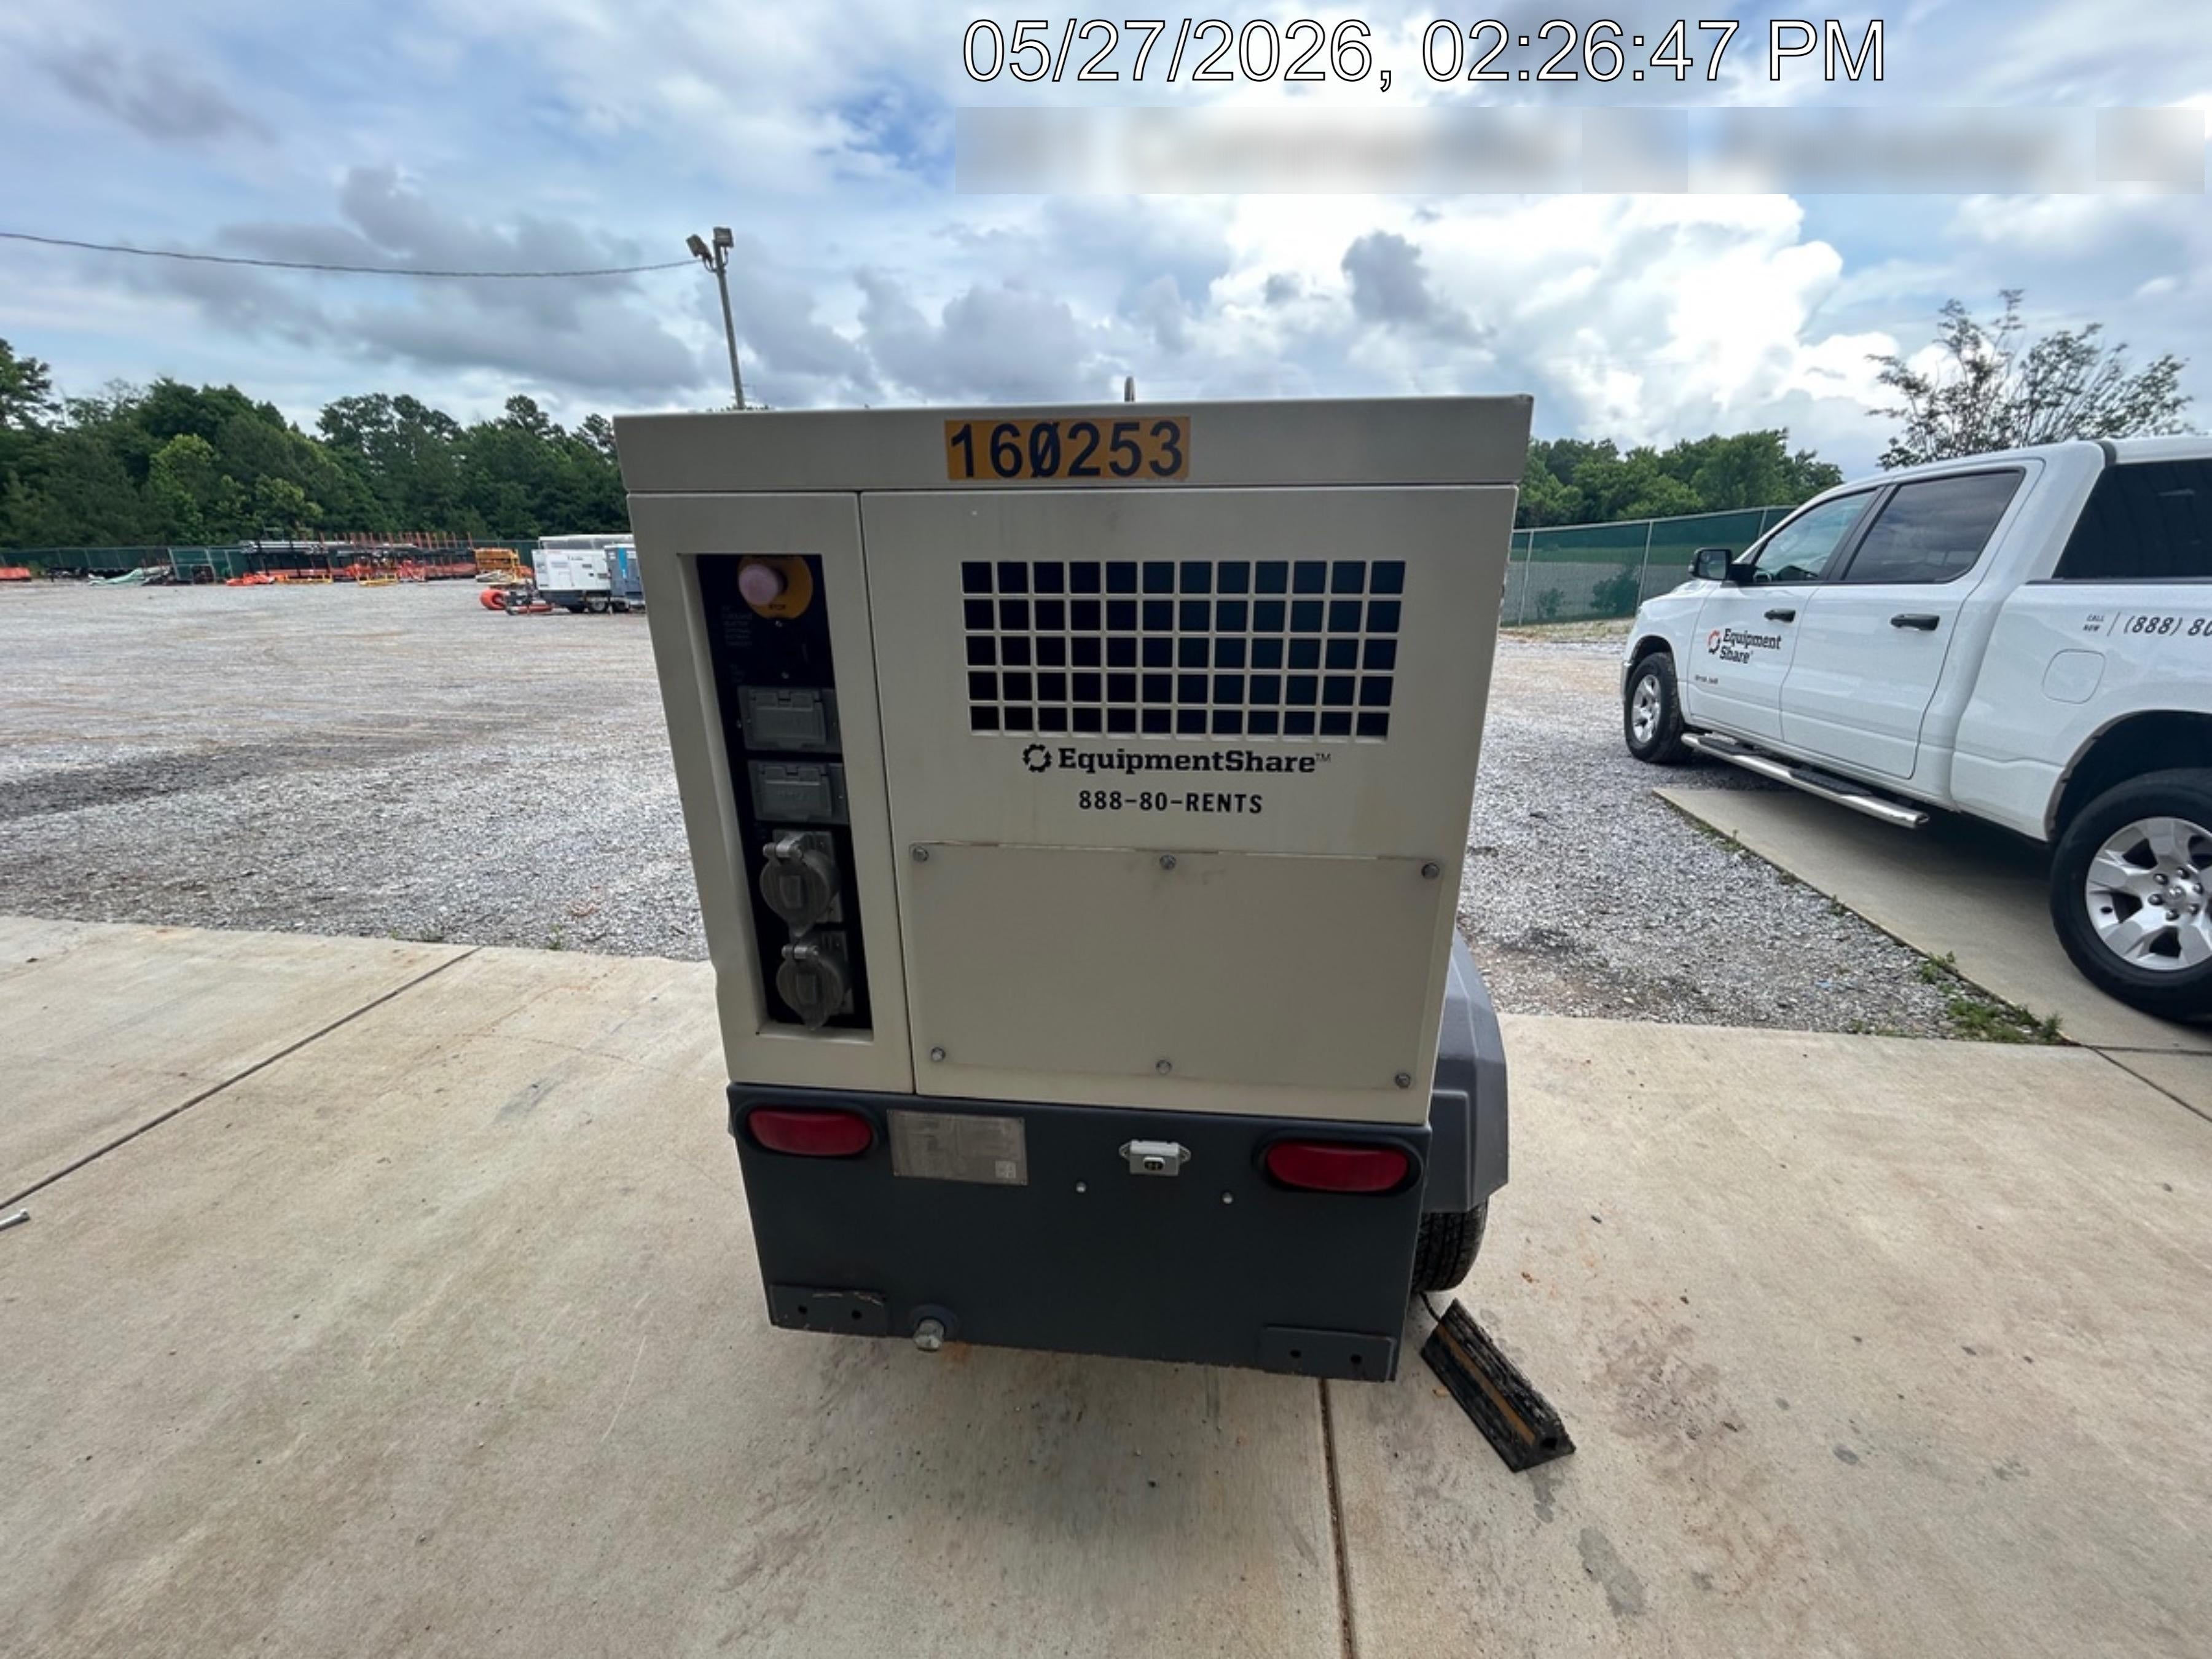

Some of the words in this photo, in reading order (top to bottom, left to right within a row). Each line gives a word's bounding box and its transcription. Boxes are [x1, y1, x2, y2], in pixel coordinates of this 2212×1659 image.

[951, 421, 1182, 478] 160253
[2124, 614, 2183, 636] (888)
[1723, 628, 1781, 649] Equipment
[1079, 790, 1263, 814] 888-80-RENTS
